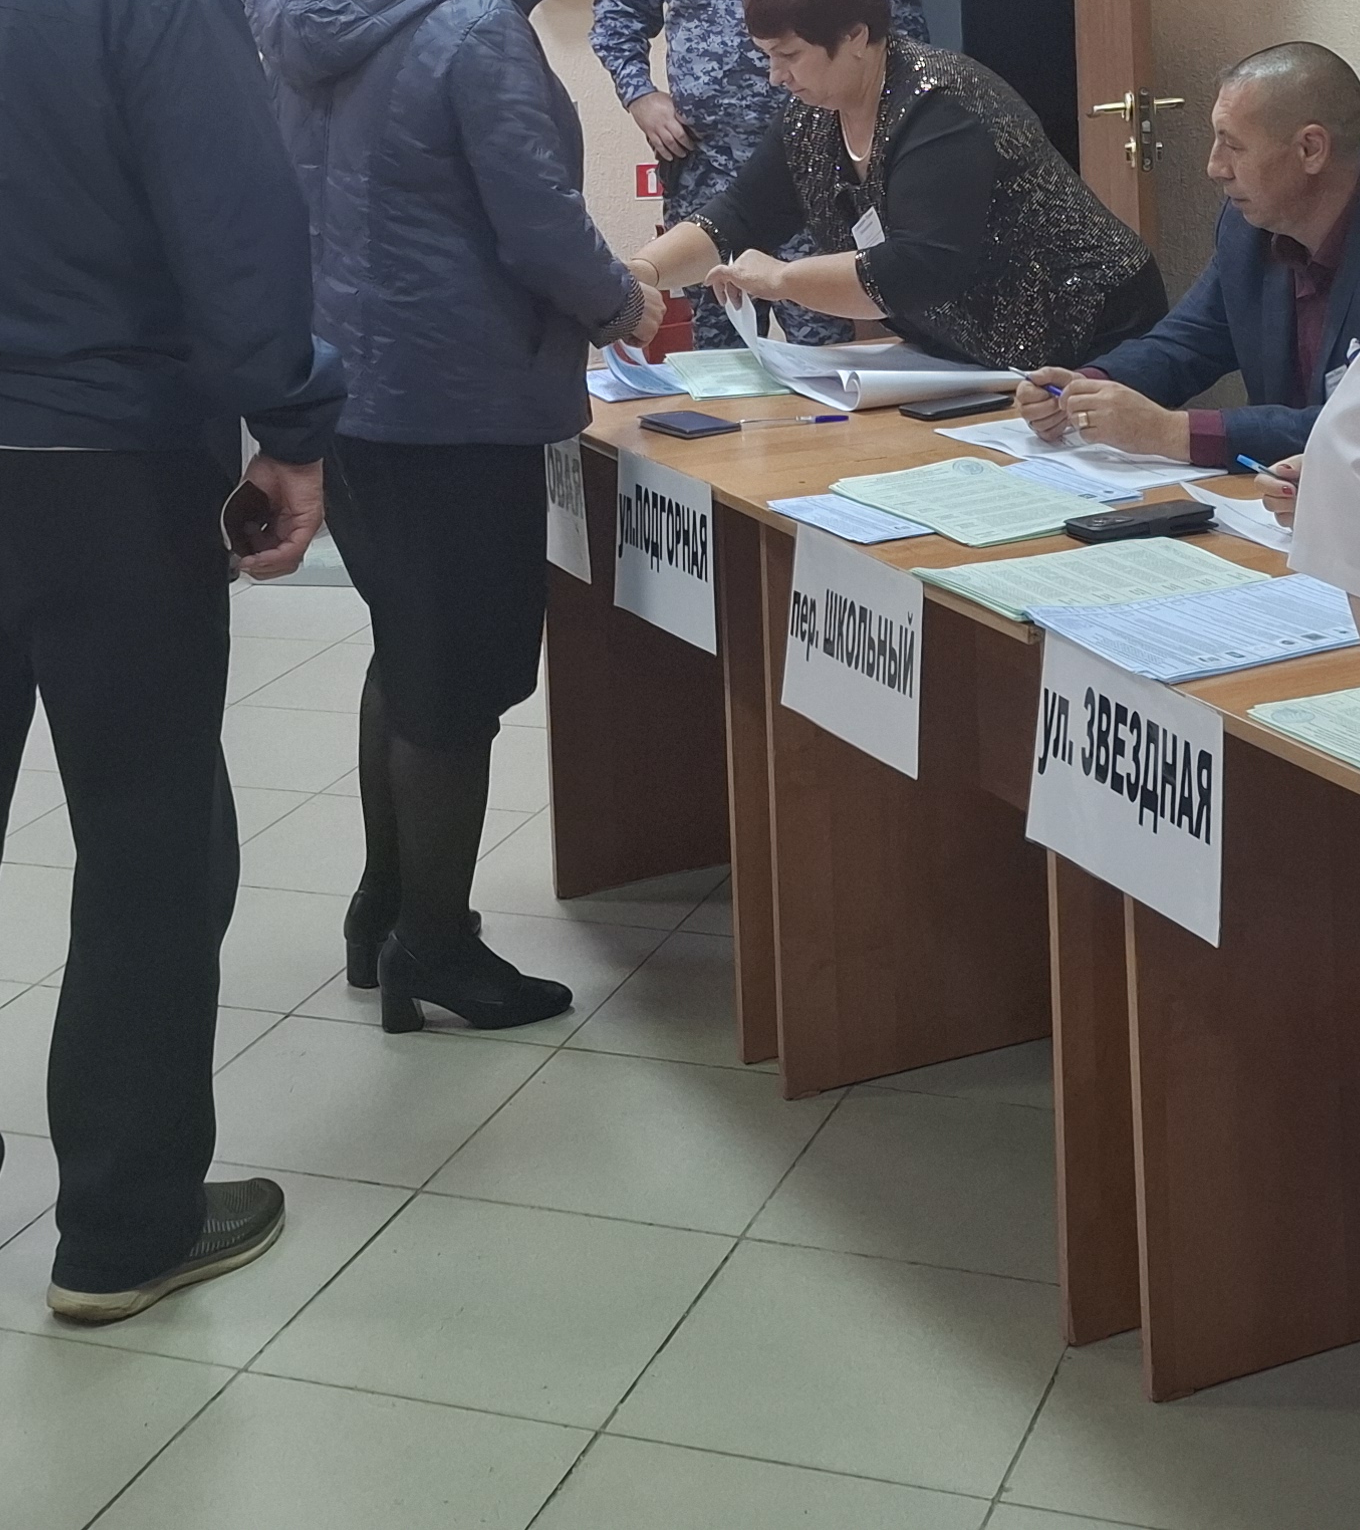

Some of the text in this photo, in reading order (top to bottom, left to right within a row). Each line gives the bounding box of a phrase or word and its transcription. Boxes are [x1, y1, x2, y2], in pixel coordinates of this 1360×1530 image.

[546, 444, 585, 521] ОВАЯ
[790, 588, 915, 699] пер. ШКОЛЬНЫЙ
[1038, 687, 1074, 775] ул.
[1081, 686, 1213, 845] ЗВЕЗДНАЯ
